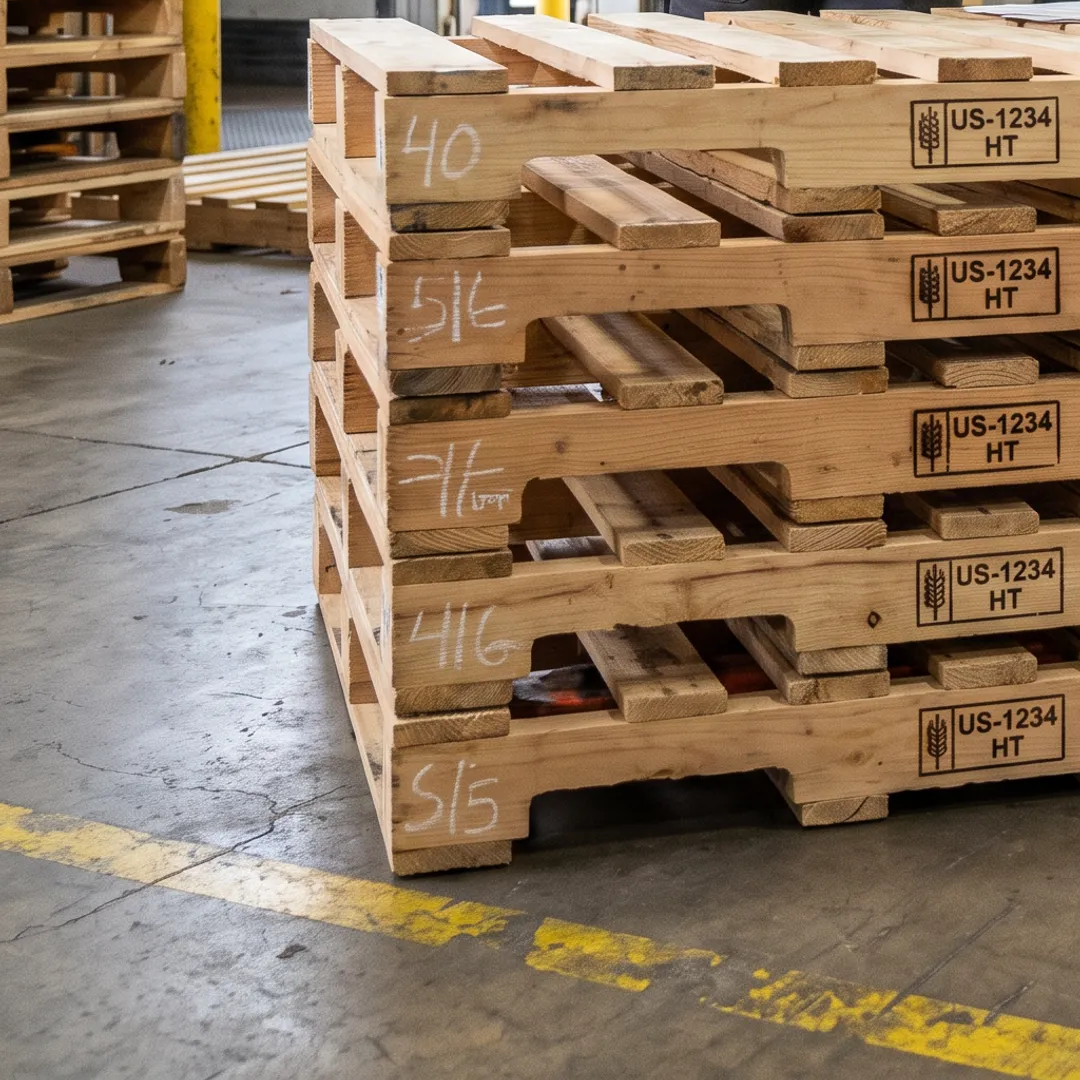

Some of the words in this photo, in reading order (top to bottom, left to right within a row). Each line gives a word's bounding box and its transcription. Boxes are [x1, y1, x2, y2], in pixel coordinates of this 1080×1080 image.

[951, 106, 1052, 130] US-1234
[401, 115, 481, 187] 40
[985, 135, 1018, 157] HT
[951, 257, 1052, 283] US-1234
[985, 287, 1019, 309] HT
[953, 410, 1053, 438] US-1234
[986, 440, 1019, 463] HT
[956, 558, 1056, 586] US-1234
[990, 588, 1023, 611] HT
[958, 705, 1058, 735] US-1234
[992, 735, 1024, 758] HT
